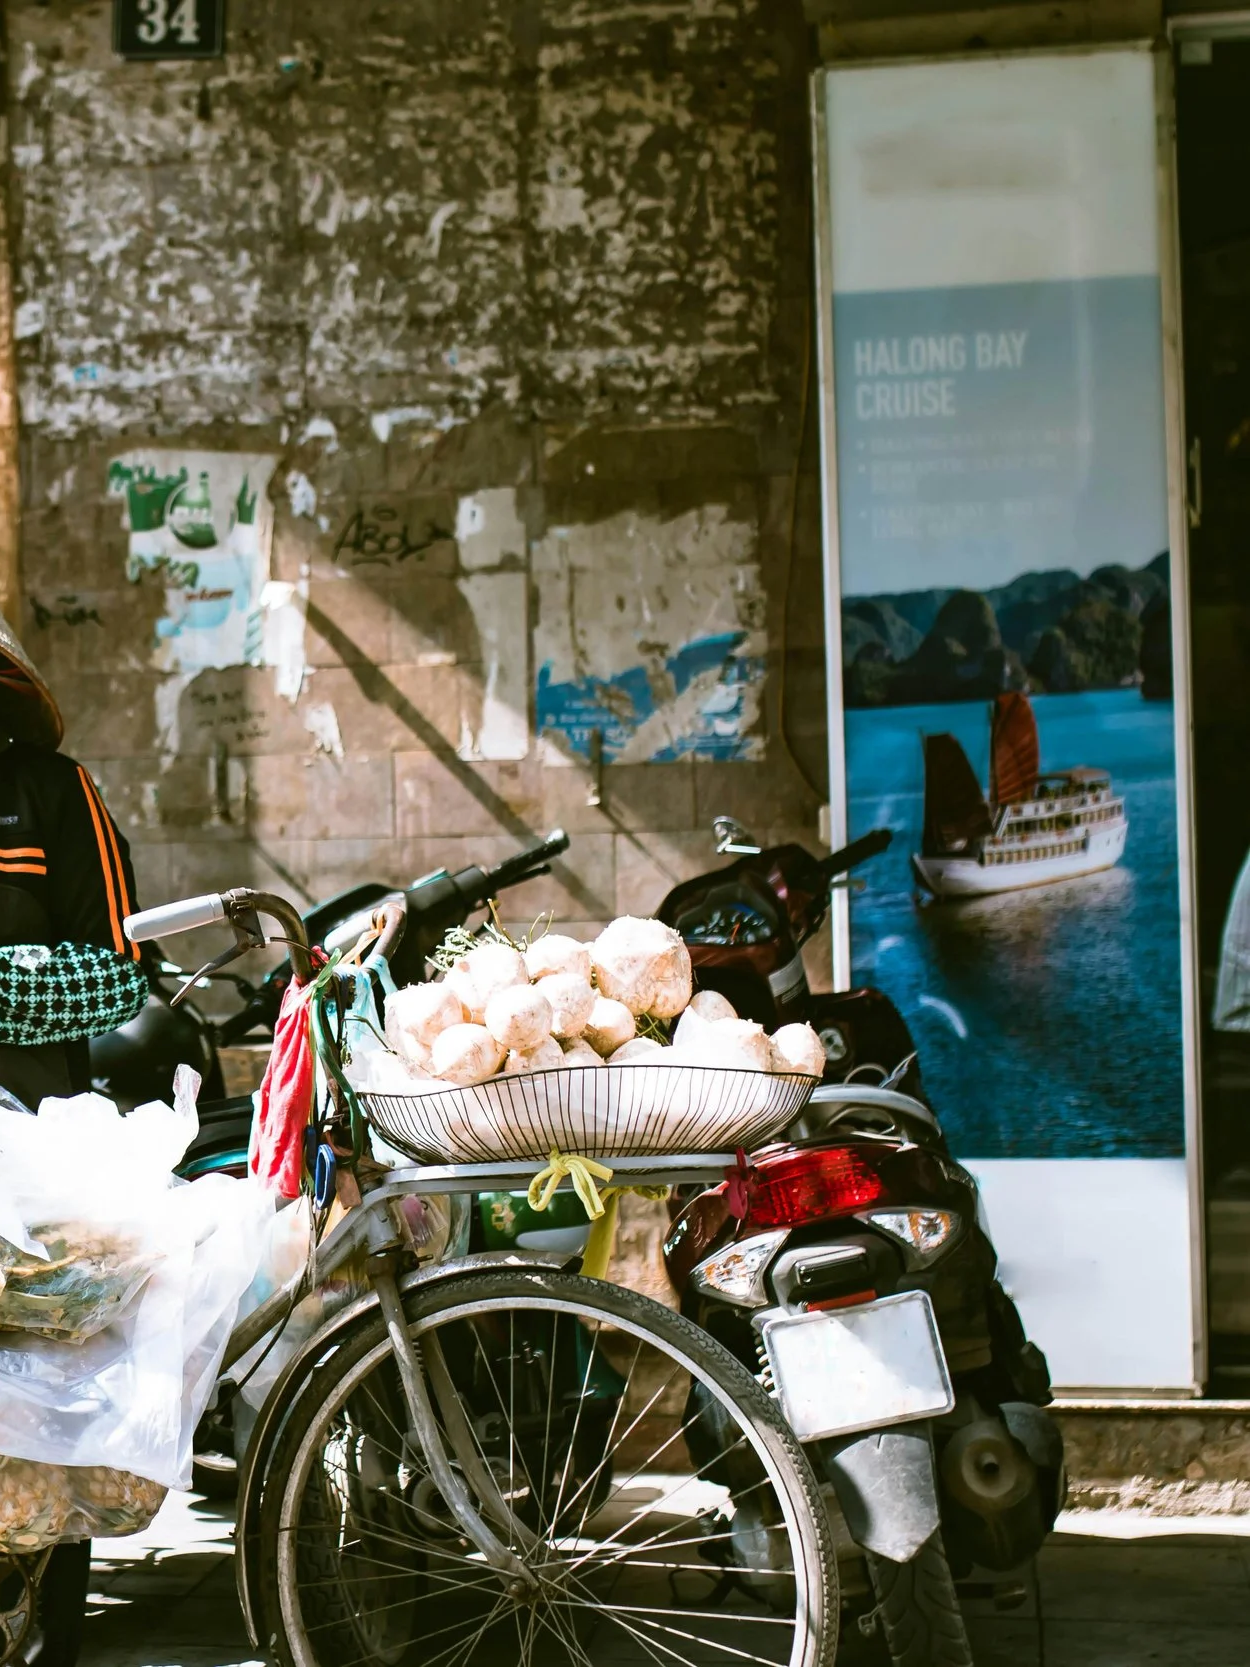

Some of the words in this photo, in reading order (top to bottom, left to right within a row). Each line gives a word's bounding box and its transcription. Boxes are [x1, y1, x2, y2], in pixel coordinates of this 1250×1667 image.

[136, 0, 200, 43] 34
[854, 335, 967, 377] HALONG
[975, 330, 1028, 369] BAY
[855, 379, 956, 420] CRUISE
